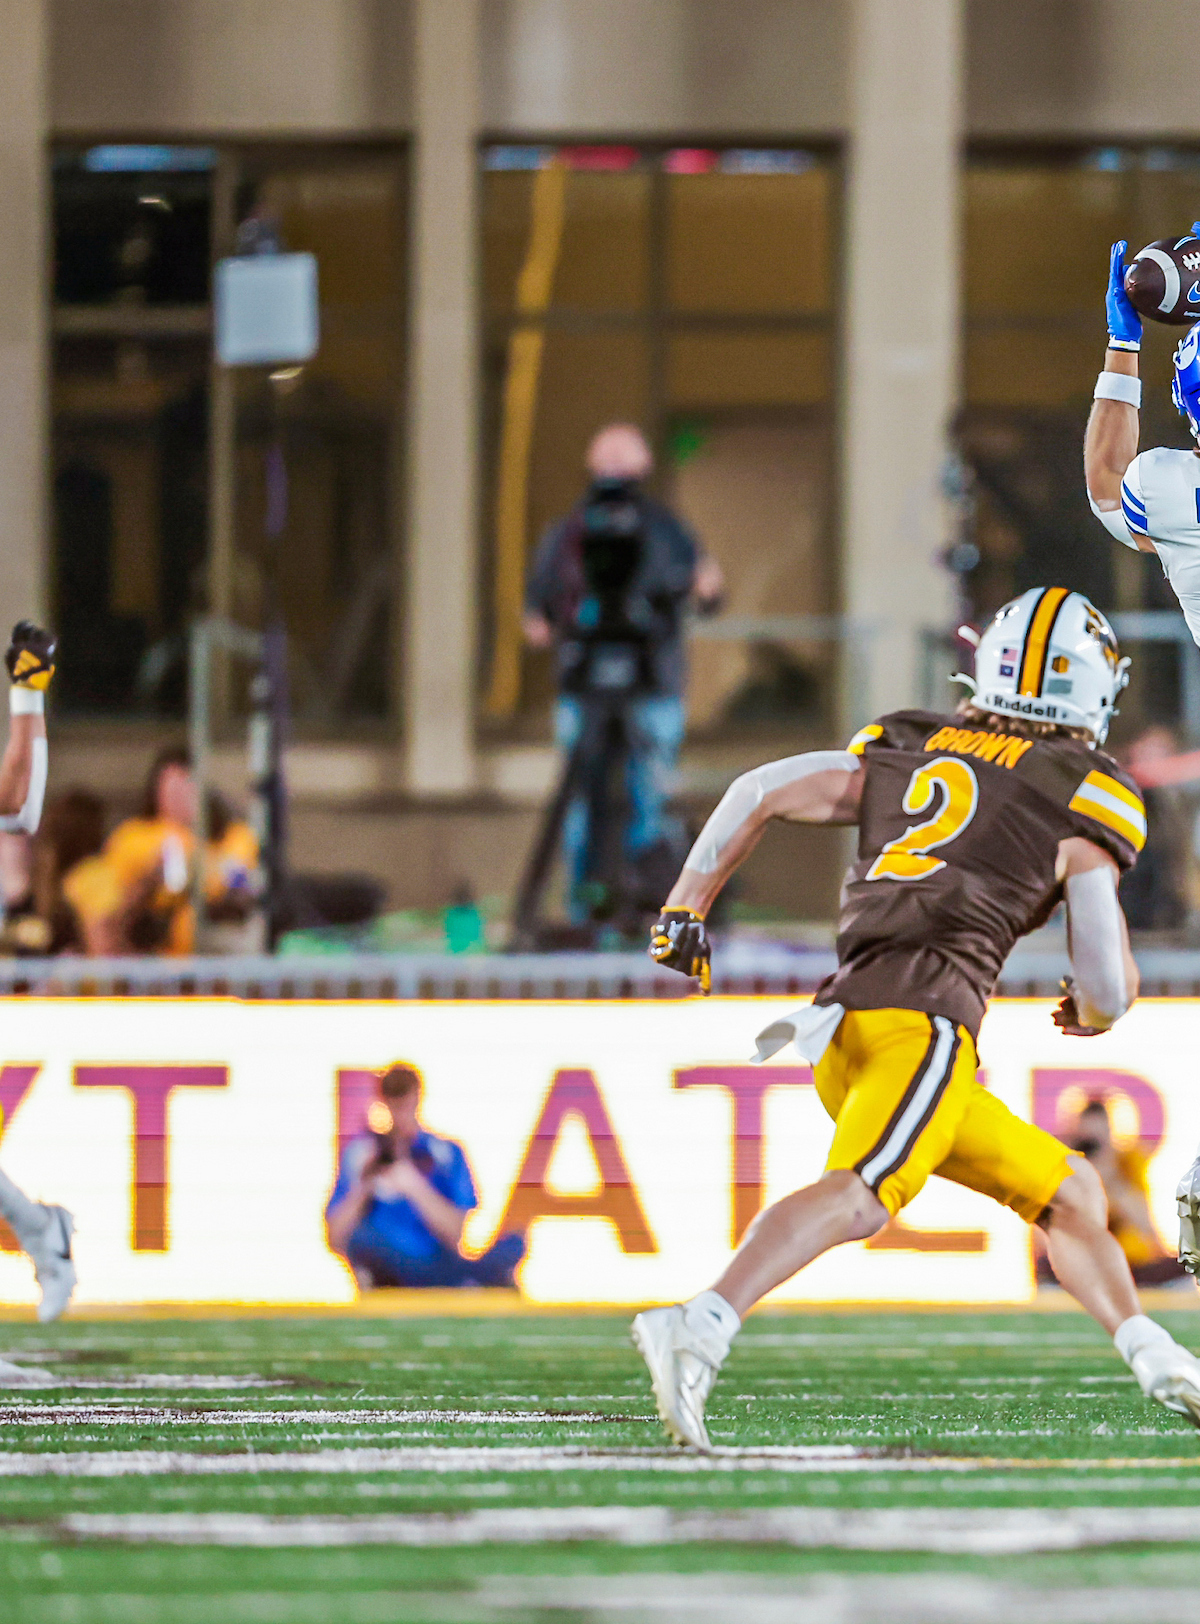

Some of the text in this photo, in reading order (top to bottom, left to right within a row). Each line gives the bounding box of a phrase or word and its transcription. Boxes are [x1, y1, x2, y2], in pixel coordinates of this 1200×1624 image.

[924, 726, 1033, 770] BROWN
[994, 695, 1057, 718] Riddell
[866, 756, 979, 881] 2
[0, 1064, 229, 1252] T
